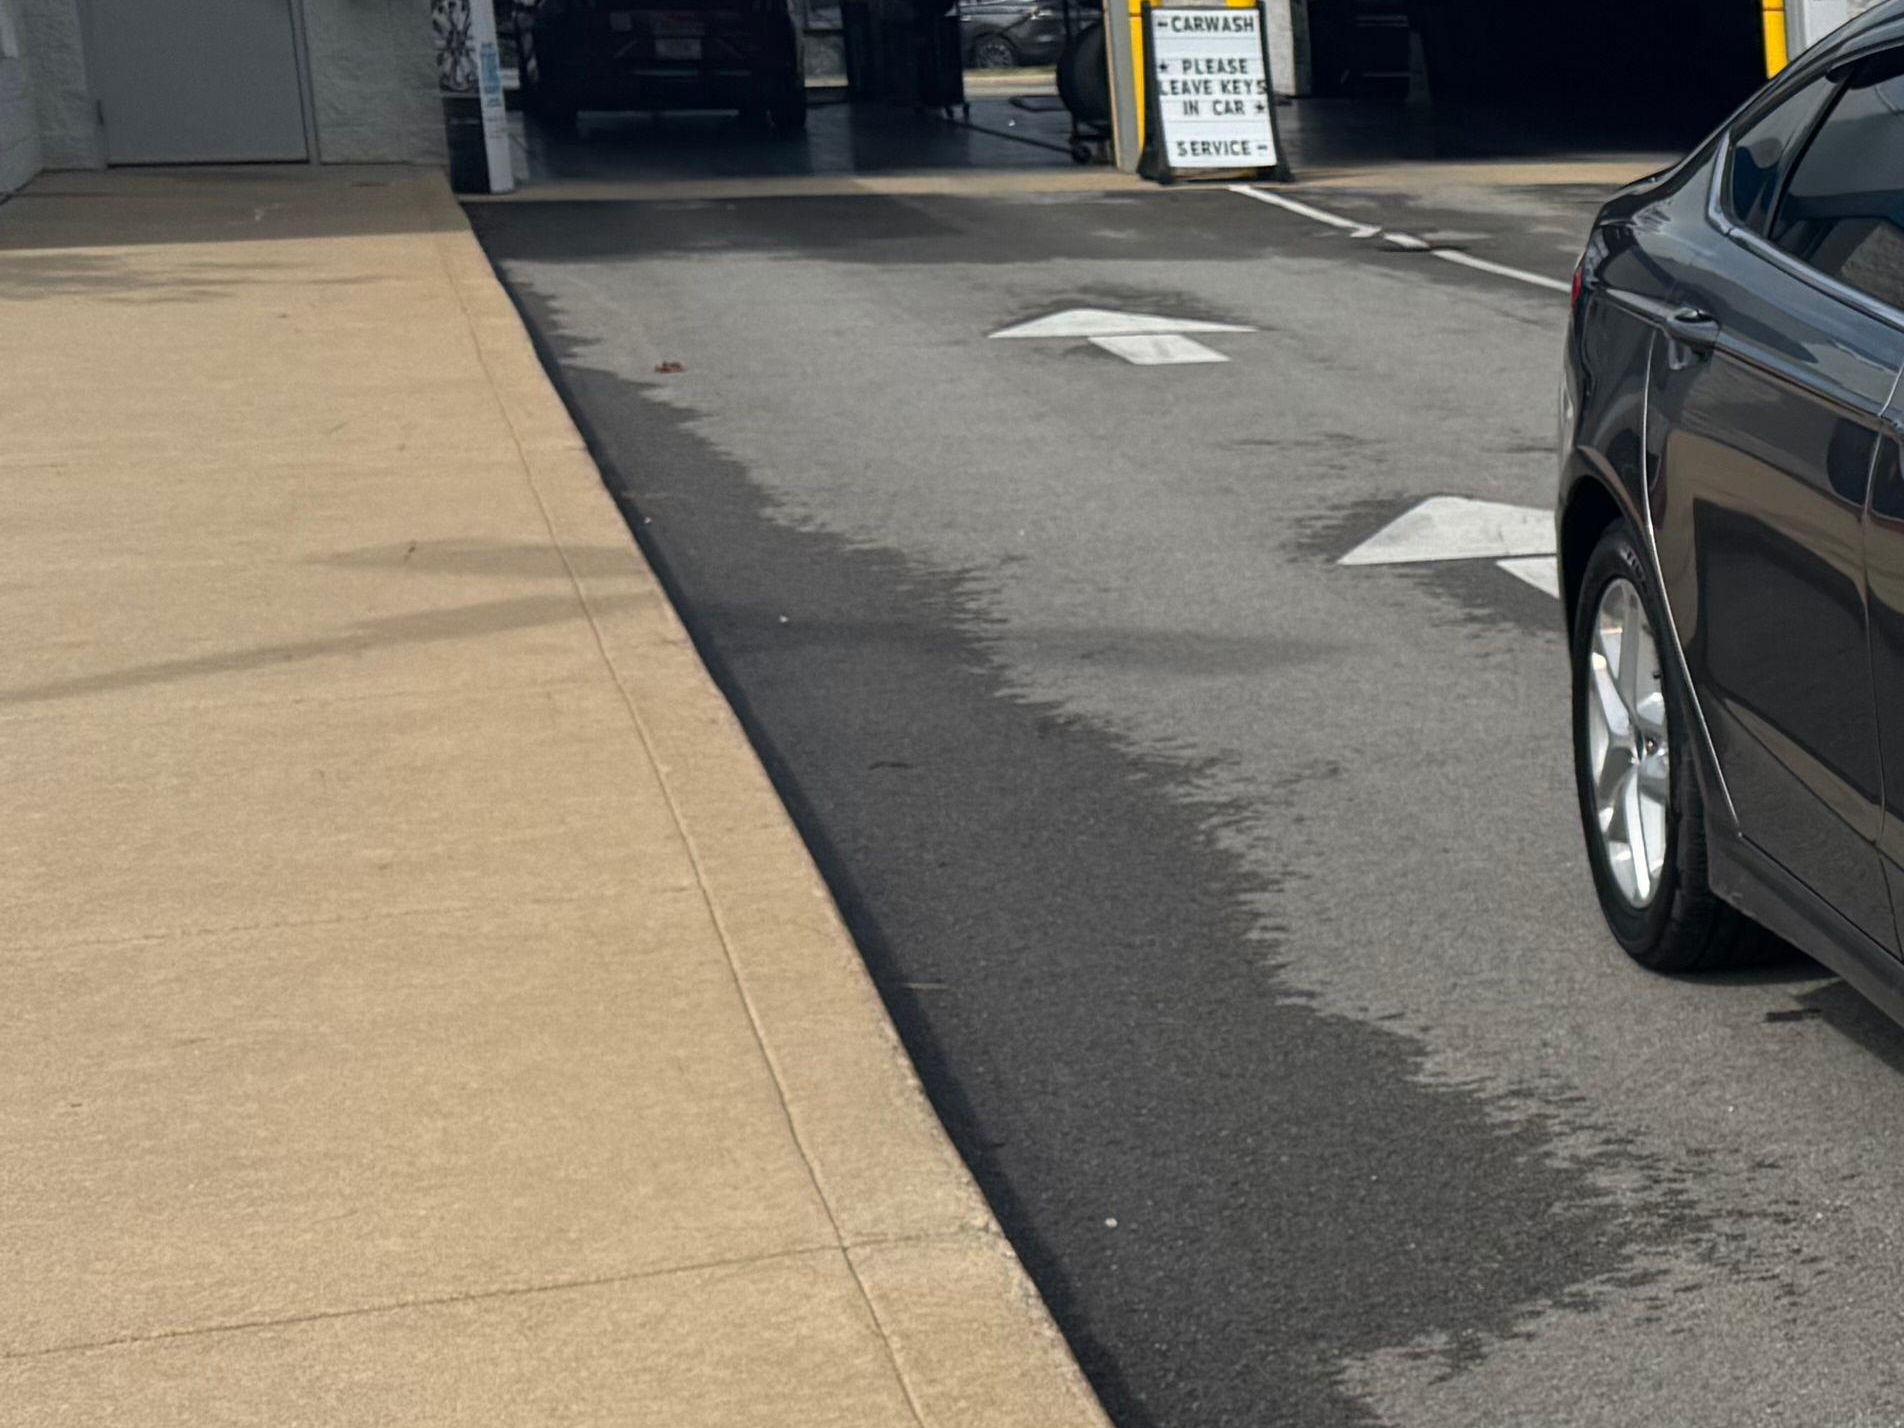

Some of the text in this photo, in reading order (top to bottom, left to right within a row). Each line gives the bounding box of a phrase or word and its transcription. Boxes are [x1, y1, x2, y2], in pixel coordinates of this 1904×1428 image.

[1171, 16, 1254, 33] CARWASH
[1182, 58, 1248, 74] PLEASE
[1161, 79, 1268, 96] LEAVE KEYS
[1184, 100, 1245, 116] IN CAR
[1177, 140, 1252, 157] SERVICE
